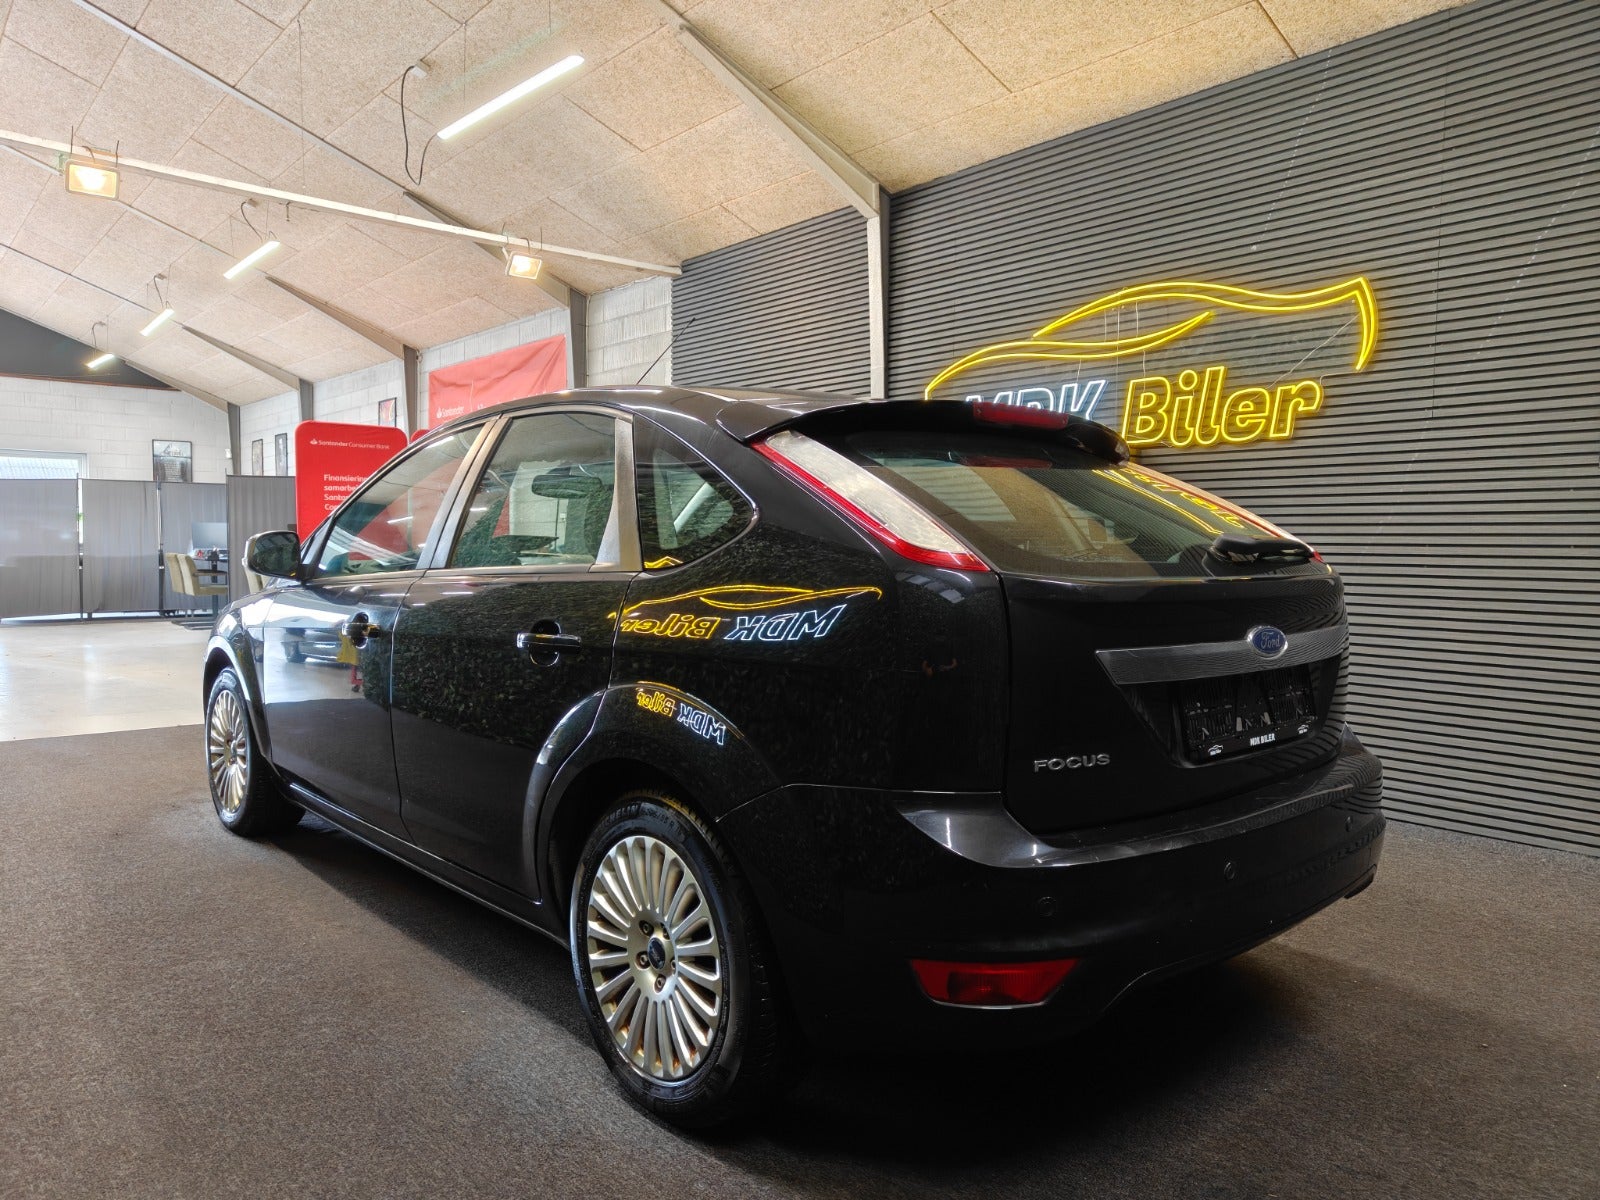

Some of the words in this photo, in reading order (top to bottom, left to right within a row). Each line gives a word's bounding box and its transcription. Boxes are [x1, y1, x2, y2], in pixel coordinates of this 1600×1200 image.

[1122, 364, 1323, 446] Biler
[319, 439, 348, 447] Santander
[348, 441, 375, 449] Consumer
[1260, 631, 1281, 649] Ford
[1033, 753, 1111, 773] FOCUS
